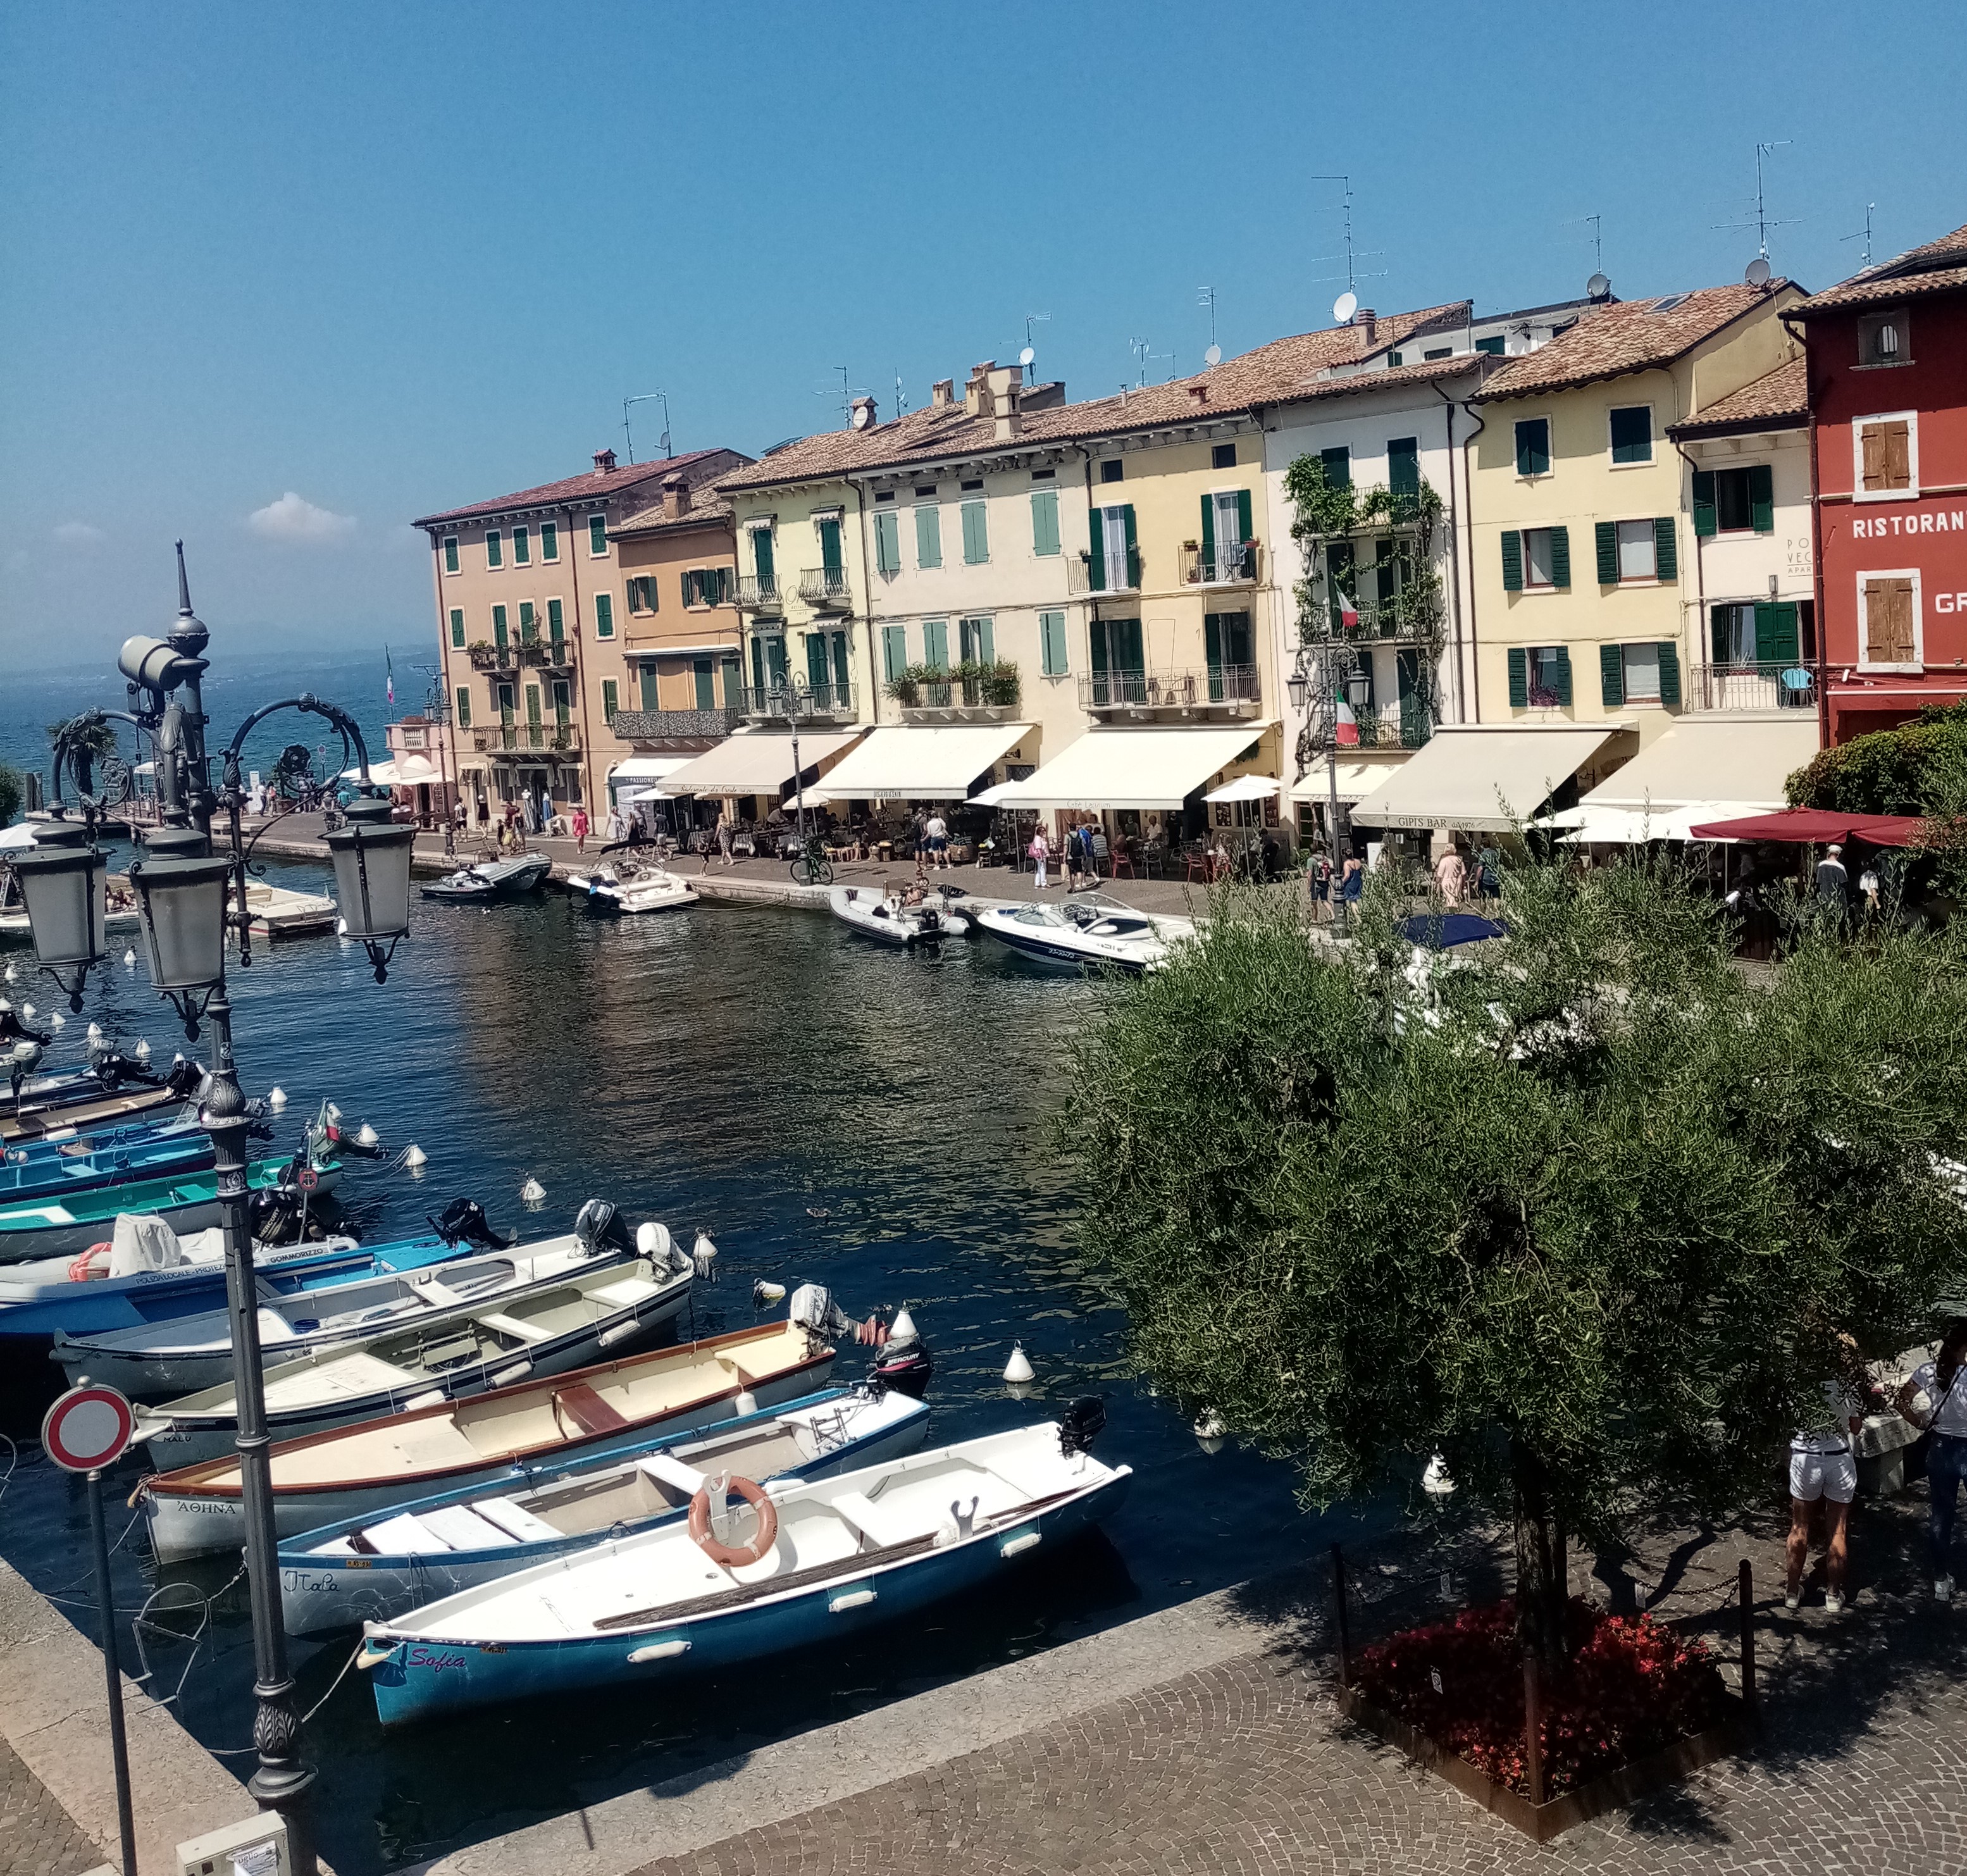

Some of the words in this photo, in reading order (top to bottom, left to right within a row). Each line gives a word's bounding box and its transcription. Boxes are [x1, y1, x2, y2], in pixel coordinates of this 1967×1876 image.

[1852, 511, 1967, 538] RISTORAN
[1427, 818, 1447, 828] BAR
[258, 1207, 280, 1238] MERCURY
[270, 1248, 323, 1264] GOMMORIZZO
[164, 1270, 190, 1280] LOCALE
[885, 1352, 920, 1367] MERCURY
[408, 1648, 467, 1674] Sofia
